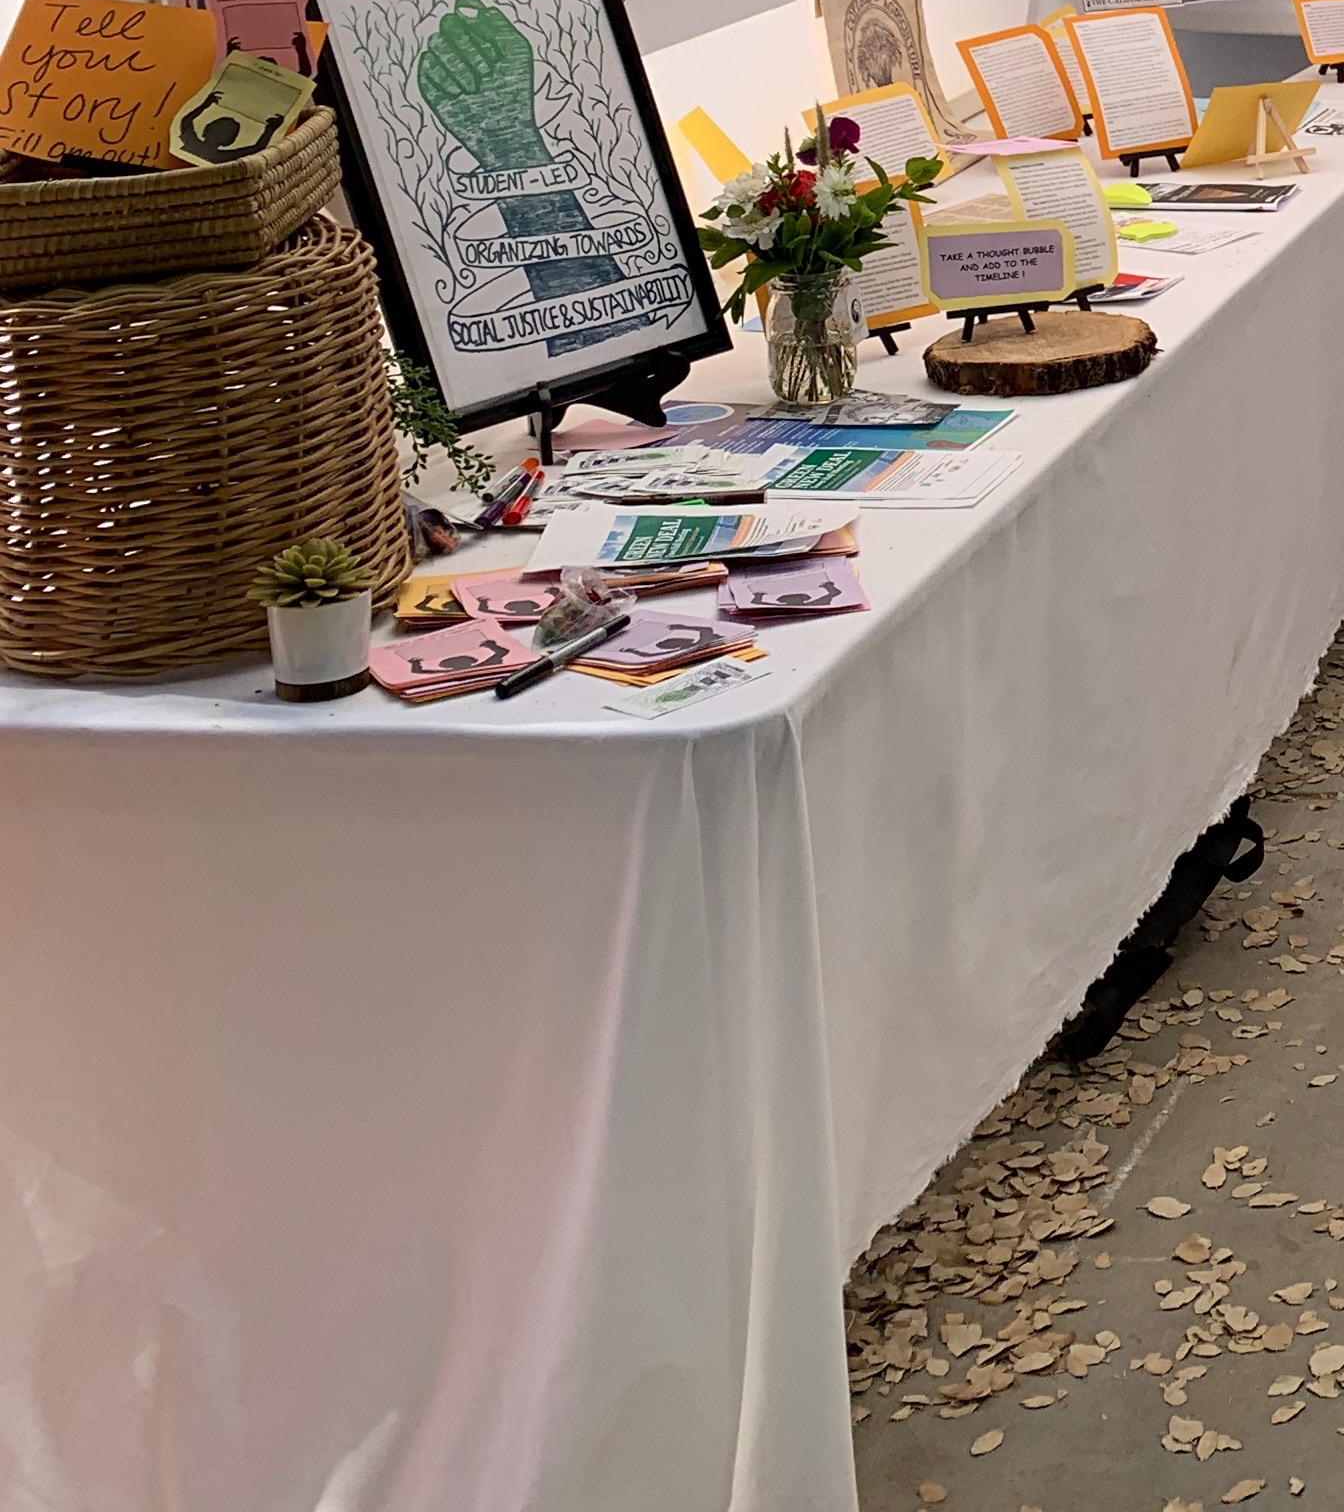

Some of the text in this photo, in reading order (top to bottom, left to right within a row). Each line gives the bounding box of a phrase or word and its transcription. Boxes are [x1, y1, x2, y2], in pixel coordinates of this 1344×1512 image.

[45, 2, 147, 40] Tell
[21, 43, 156, 83] your
[0, 80, 177, 145] Story!
[464, 221, 648, 265] ORGANIZING TOWARDS
[940, 245, 1054, 262] TAKE A THOUGHT BUBBLE
[960, 258, 1038, 271] AND ADD TO THE
[975, 271, 1019, 282] TIMELINE
[450, 315, 504, 349] SOCIAL
[506, 307, 560, 344] JUSTICE
[571, 271, 691, 326] SUSTAINABILITY
